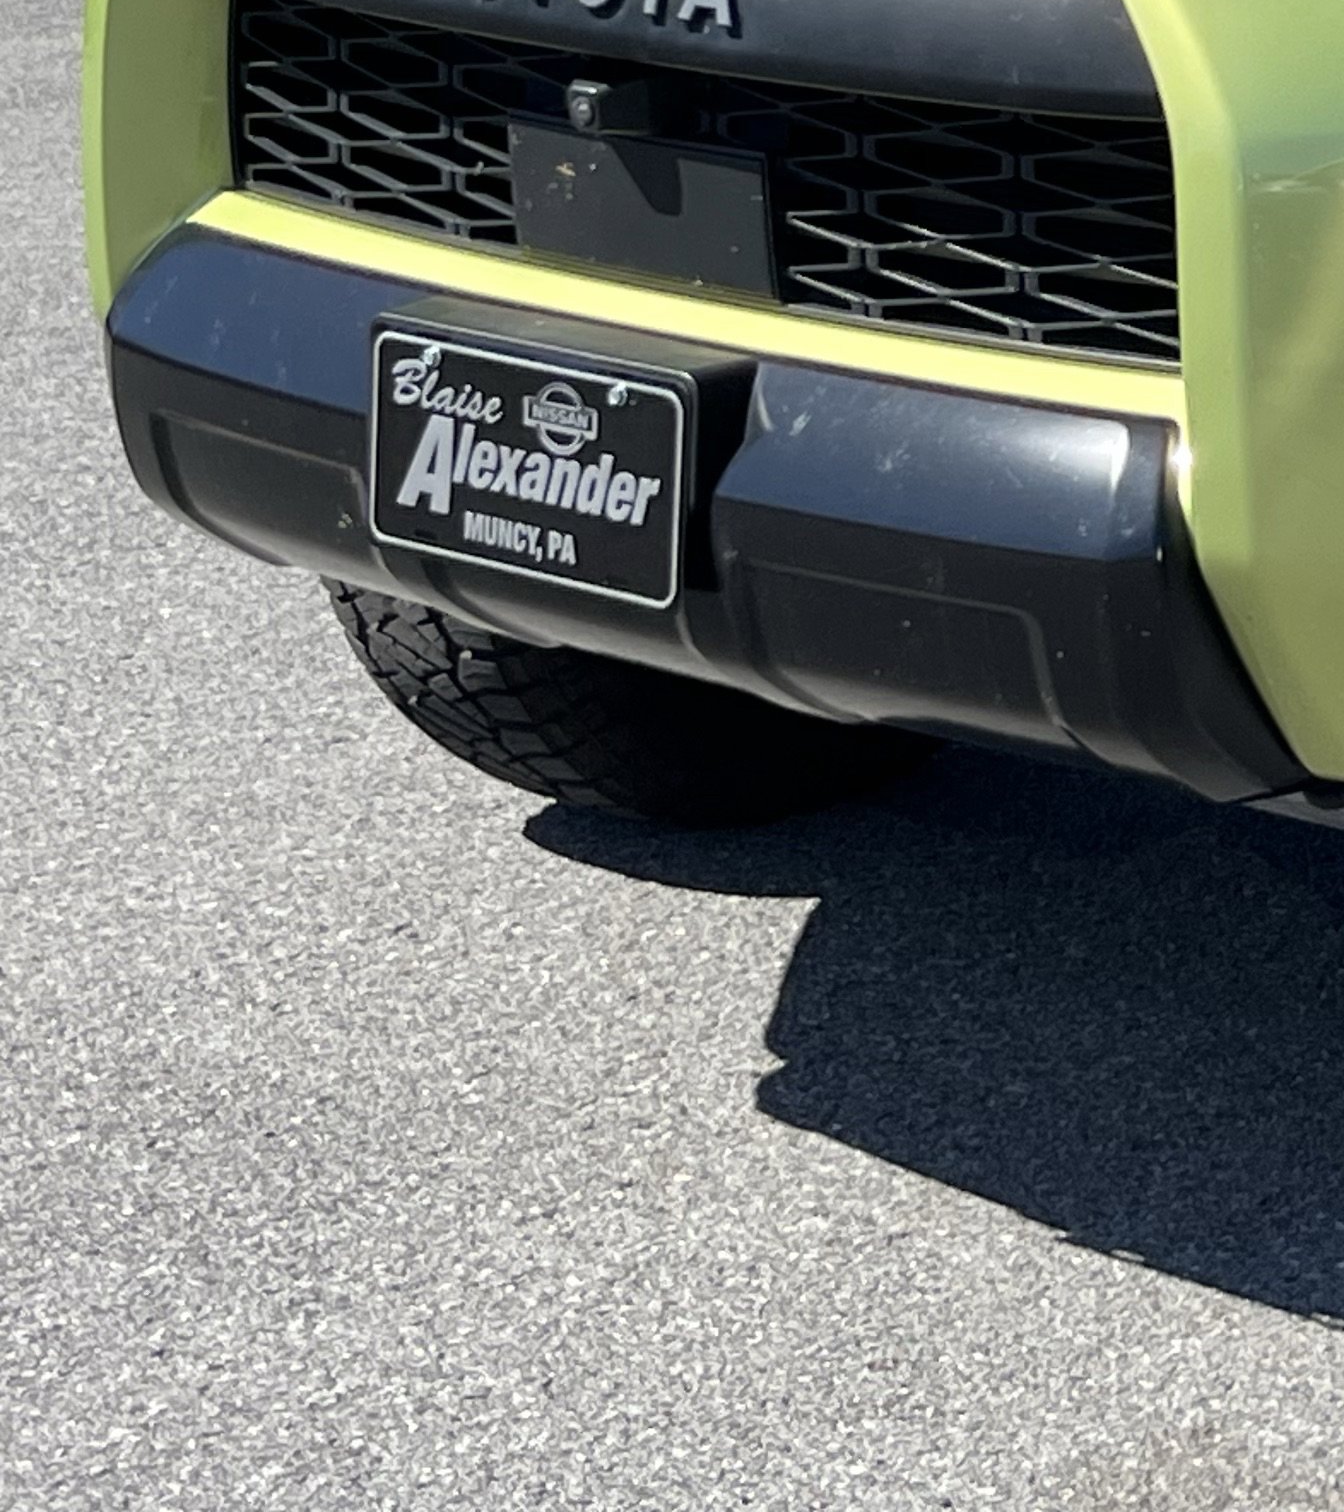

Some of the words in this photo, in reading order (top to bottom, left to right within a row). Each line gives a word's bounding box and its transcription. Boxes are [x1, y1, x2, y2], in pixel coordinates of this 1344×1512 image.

[390, 357, 506, 426] Blaise
[531, 403, 590, 430] NISSAN
[396, 414, 661, 527] Alexander
[463, 510, 543, 564] MUNCY,
[548, 530, 577, 566] PA
